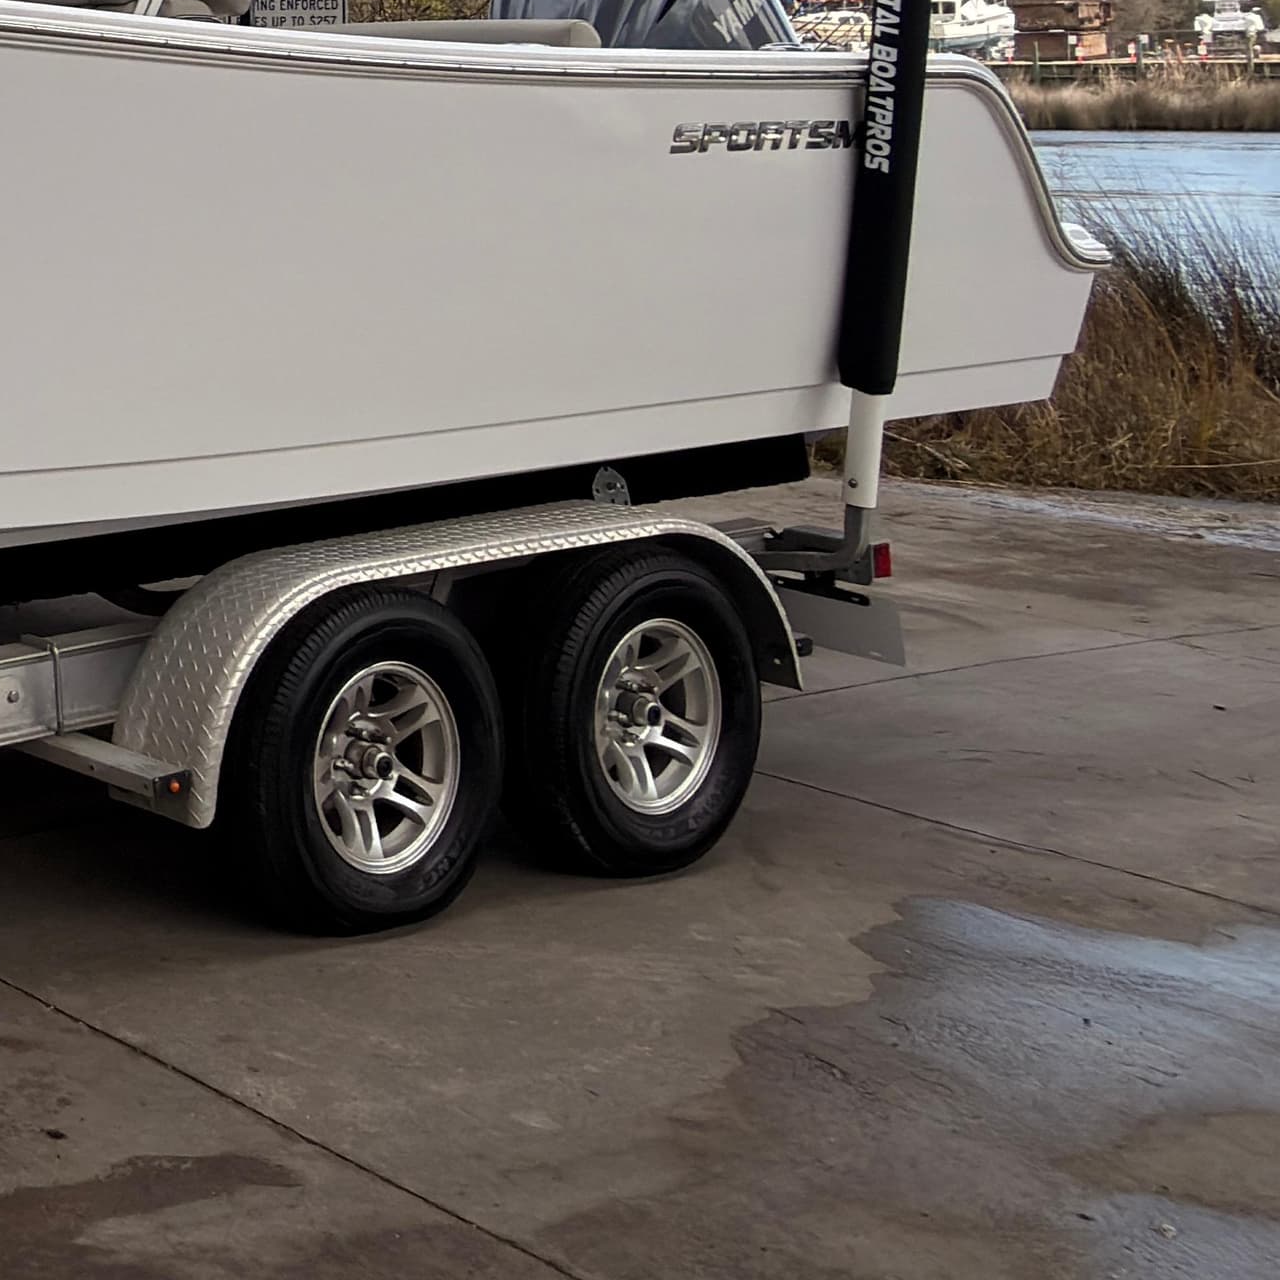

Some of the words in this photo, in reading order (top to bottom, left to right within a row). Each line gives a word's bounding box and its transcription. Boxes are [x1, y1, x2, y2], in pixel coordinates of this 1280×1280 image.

[256, 0, 276, 11] ING
[272, 16, 287, 28] UP
[292, 15, 305, 27] TO
[669, 120, 856, 154] SPORTSM
